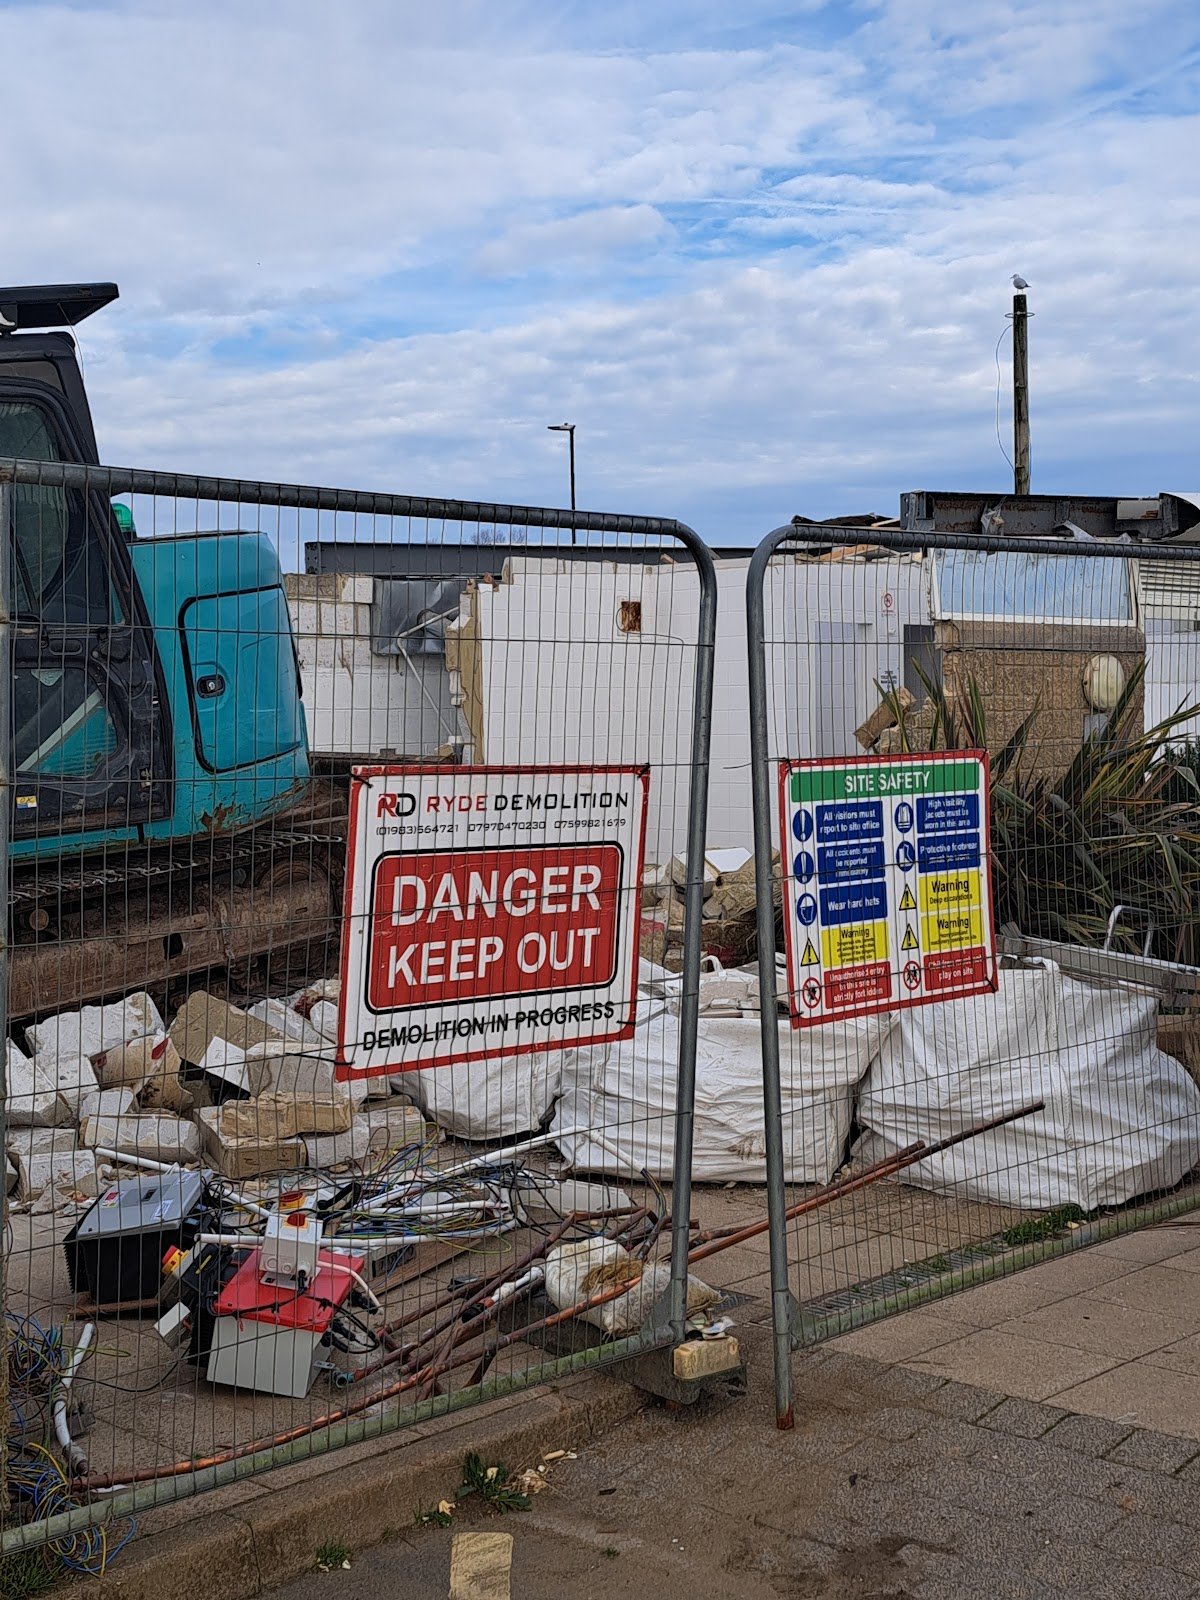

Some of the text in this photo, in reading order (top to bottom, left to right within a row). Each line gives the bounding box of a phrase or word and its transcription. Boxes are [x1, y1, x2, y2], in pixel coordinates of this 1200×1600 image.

[845, 771, 930, 793] SITE SAFETY
[427, 795, 488, 812] RYDE
[494, 792, 628, 811] DEMOLITION
[928, 800, 941, 810] High
[824, 811, 832, 821] All
[859, 809, 876, 818] must
[841, 823, 848, 832] to
[862, 820, 880, 830] office
[826, 849, 834, 858] All
[931, 879, 969, 893] Warning
[391, 864, 602, 927] DANGER
[828, 896, 880, 911] Wear hard hats
[937, 917, 969, 929] Warning
[841, 928, 870, 938] Warning
[387, 928, 601, 989] KEEP OUT
[870, 966, 885, 975] entry
[939, 970, 952, 981] play
[963, 967, 974, 976] site
[363, 1001, 615, 1051] DEMOLITION IN PROGRESS
